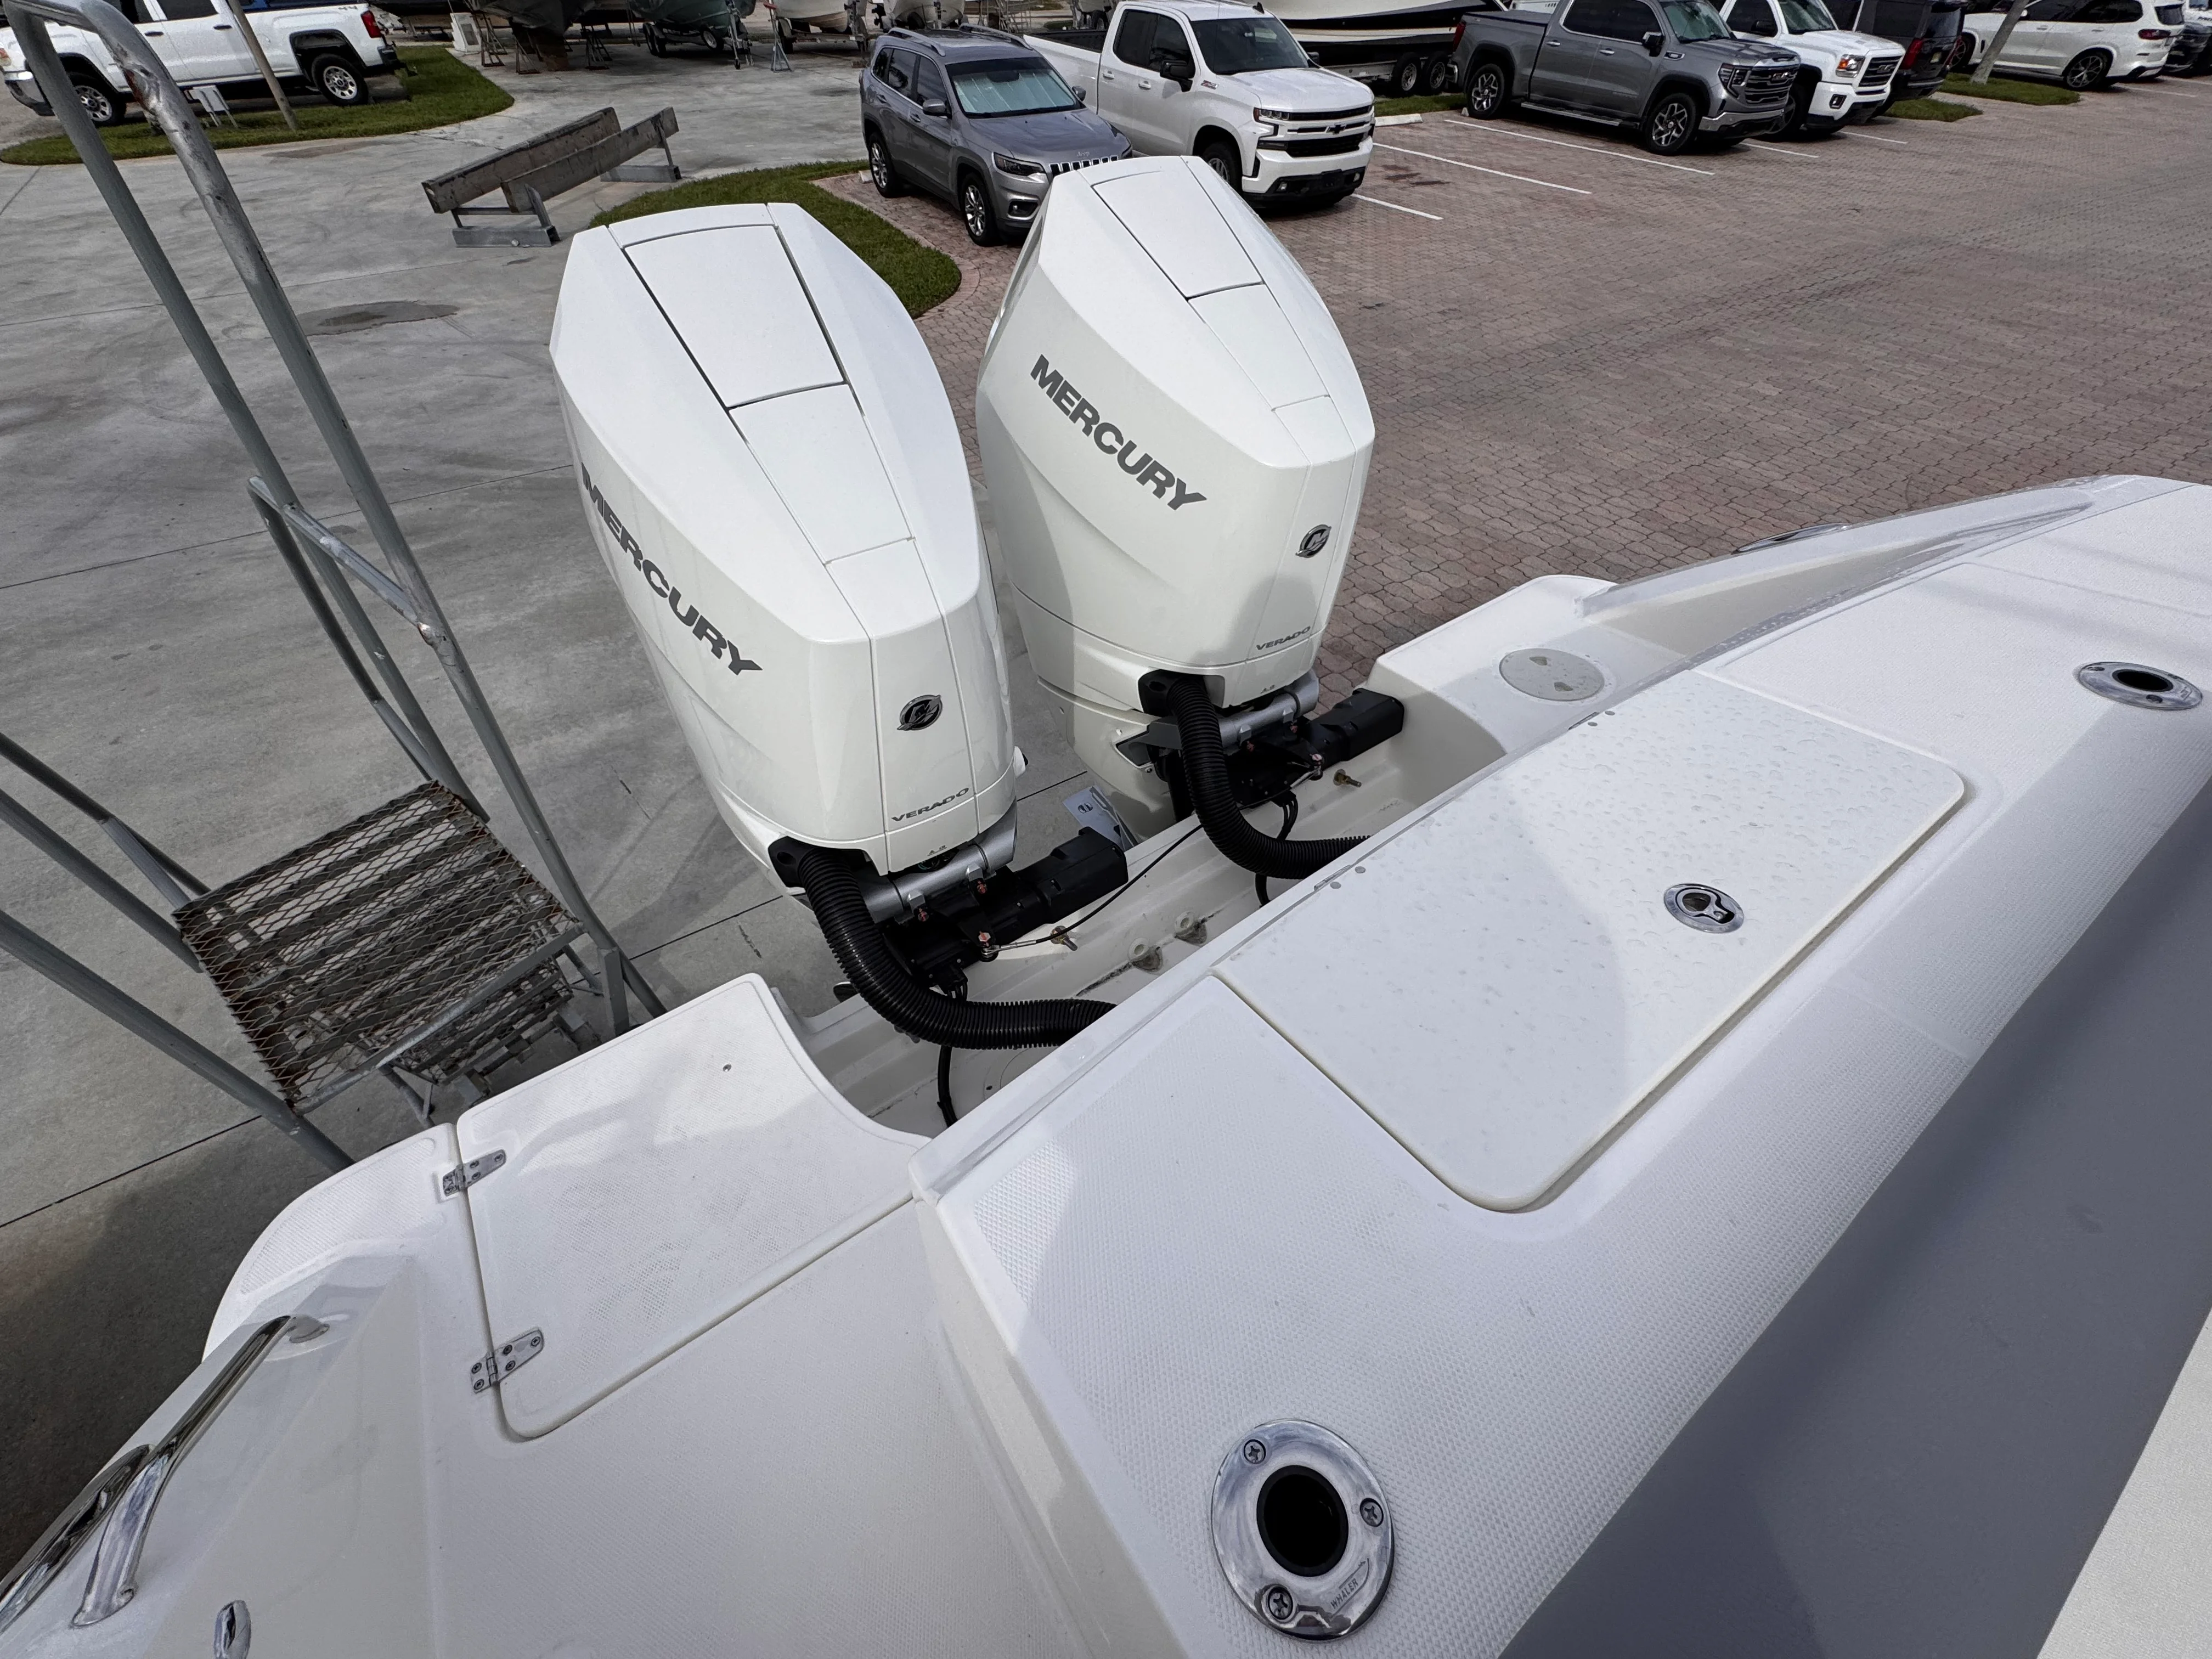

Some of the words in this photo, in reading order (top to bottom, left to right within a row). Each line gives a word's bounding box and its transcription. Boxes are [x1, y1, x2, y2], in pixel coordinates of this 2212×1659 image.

[1030, 354, 1207, 511] MERCURY
[581, 462, 763, 675] MERCURY
[1256, 626, 1311, 650] VERADO
[891, 787, 969, 822] VERADO
[1330, 1577, 1359, 1609] WHALER
